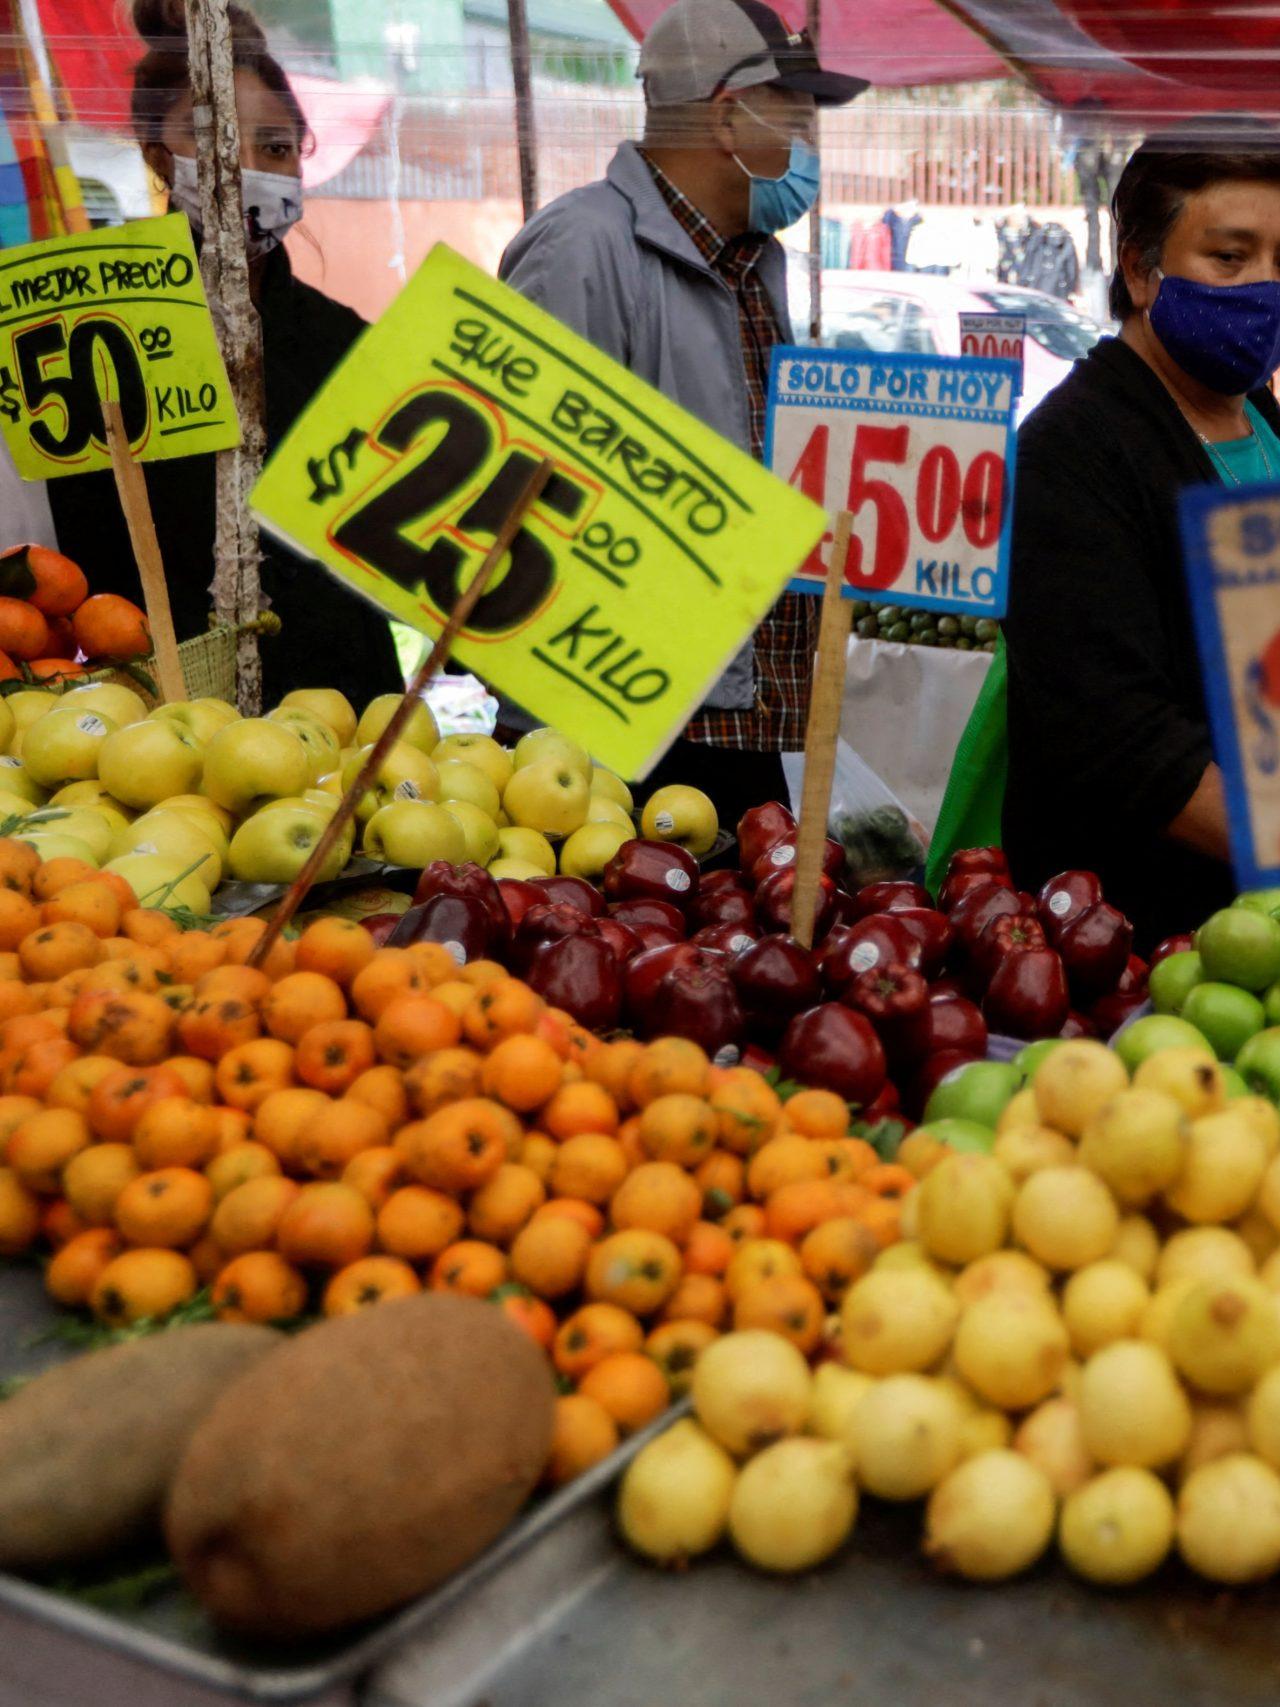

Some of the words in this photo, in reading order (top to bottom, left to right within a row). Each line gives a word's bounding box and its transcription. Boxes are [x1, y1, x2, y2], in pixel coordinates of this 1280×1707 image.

[154, 382, 218, 423] KILO
[787, 363, 861, 395] SOLO
[868, 366, 929, 399] POR
[938, 373, 1005, 408] HOY
[915, 557, 998, 601] KILO
[548, 604, 672, 706] KILO
